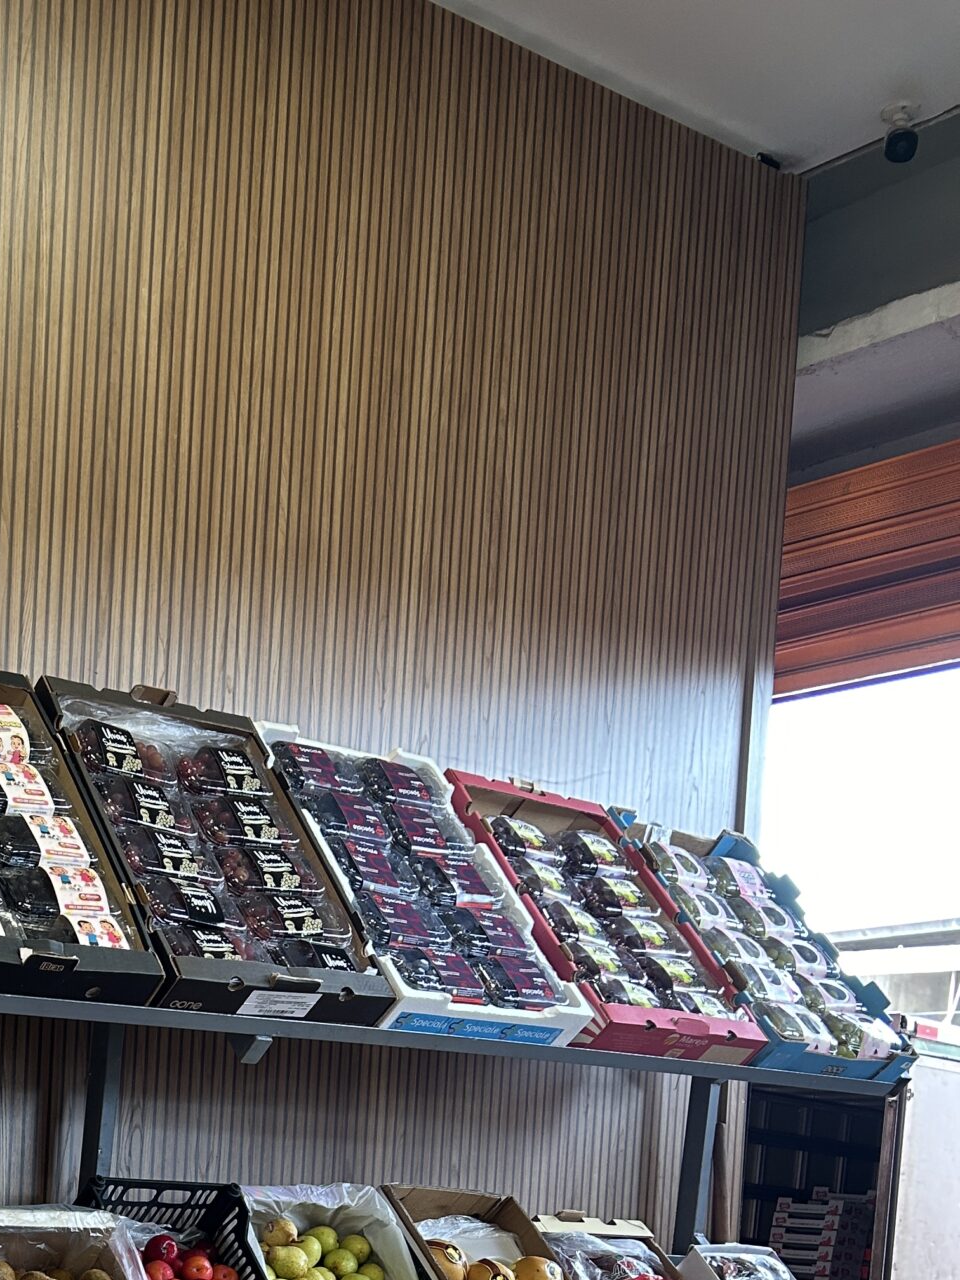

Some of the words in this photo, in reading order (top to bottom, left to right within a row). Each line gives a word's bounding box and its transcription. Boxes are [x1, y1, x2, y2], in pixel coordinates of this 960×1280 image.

[101, 726, 127, 742] Uvas
[218, 750, 243, 763] Uvas
[133, 782, 160, 798] Uvas
[234, 801, 261, 813] Uvas
[155, 832, 182, 847] Uvas
[253, 850, 282, 861] Uvas
[274, 896, 302, 907] Uvas
[192, 929, 222, 941] Uvas
[463, 1022, 501, 1035] Speciale
[514, 1027, 551, 1040] Speciale
